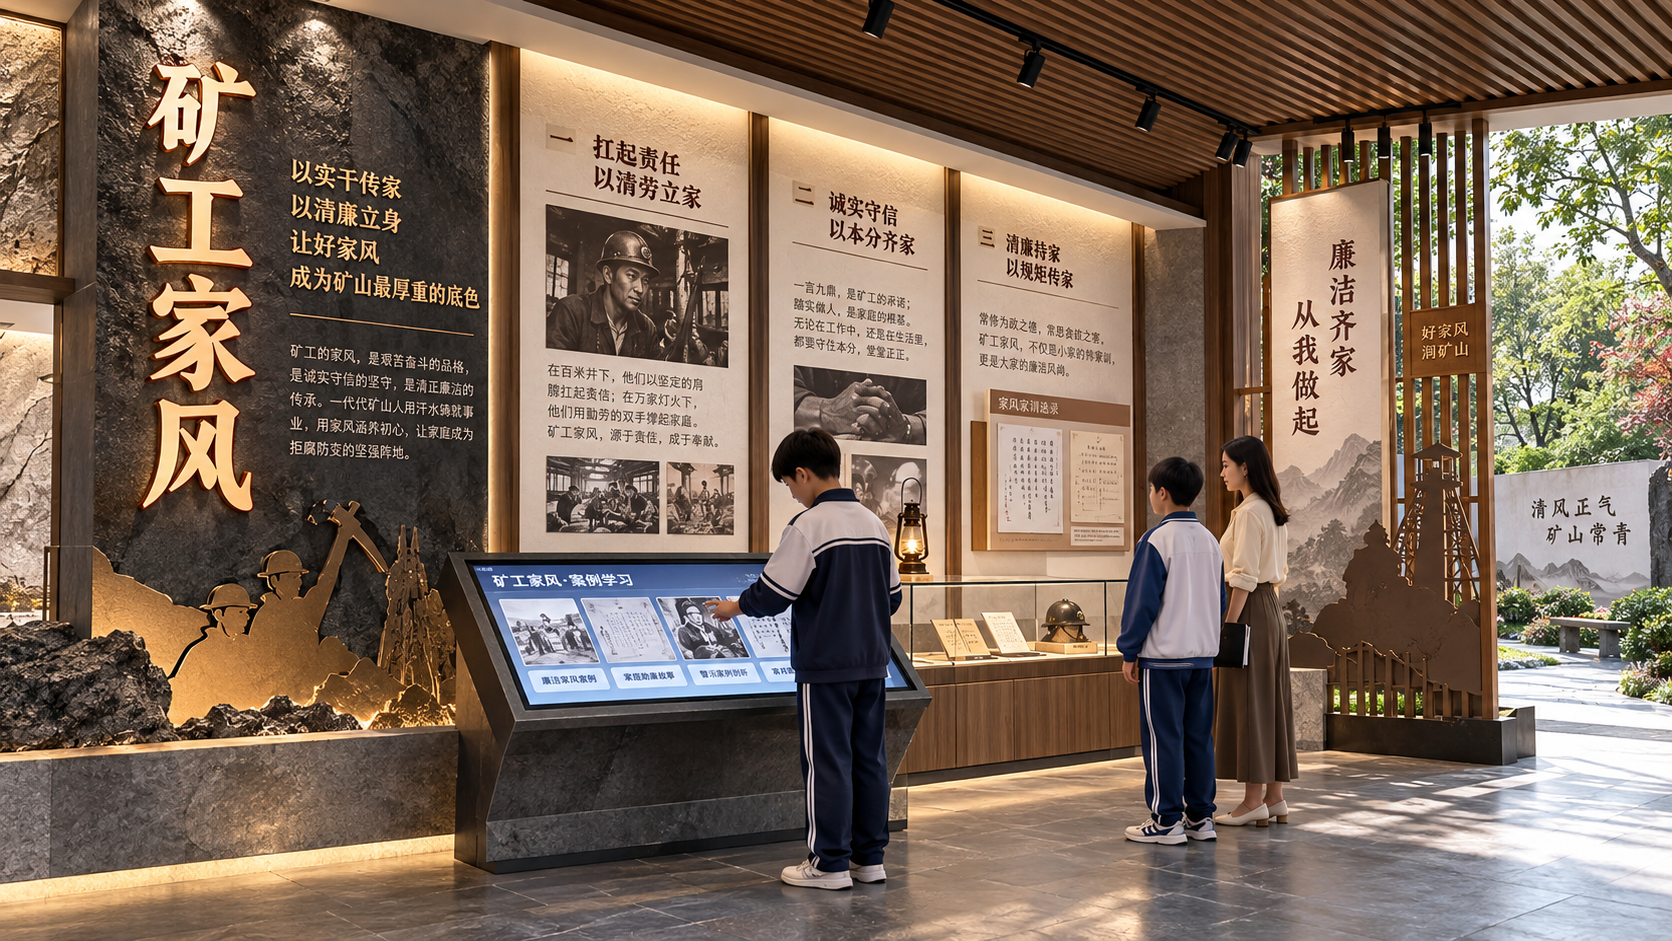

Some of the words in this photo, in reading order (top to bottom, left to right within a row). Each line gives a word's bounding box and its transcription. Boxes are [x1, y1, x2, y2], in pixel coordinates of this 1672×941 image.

[593, 134, 680, 176] 扛起责任
[290, 159, 402, 199] 以实干传家
[594, 165, 702, 209] 以清劳立家
[290, 194, 402, 234] 以清廉立身
[795, 186, 815, 206] 二
[828, 191, 898, 227] 诚实守信
[290, 229, 380, 265] 让好家风
[829, 219, 915, 256] 以本分齐家
[980, 229, 995, 248] 三
[1006, 233, 1061, 263] 清廉持家
[144, 61, 257, 512] 矿工家风
[290, 265, 481, 310] 成为矿山最厚重的底色
[1006, 257, 1074, 289] 以规矩传家
[1328, 239, 1357, 377] 廉洁齐家
[1421, 321, 1469, 341] 好家风
[1291, 299, 1320, 436] 从我做起
[1531, 495, 1617, 519] 清风正气
[1546, 522, 1631, 546] 矿山常青
